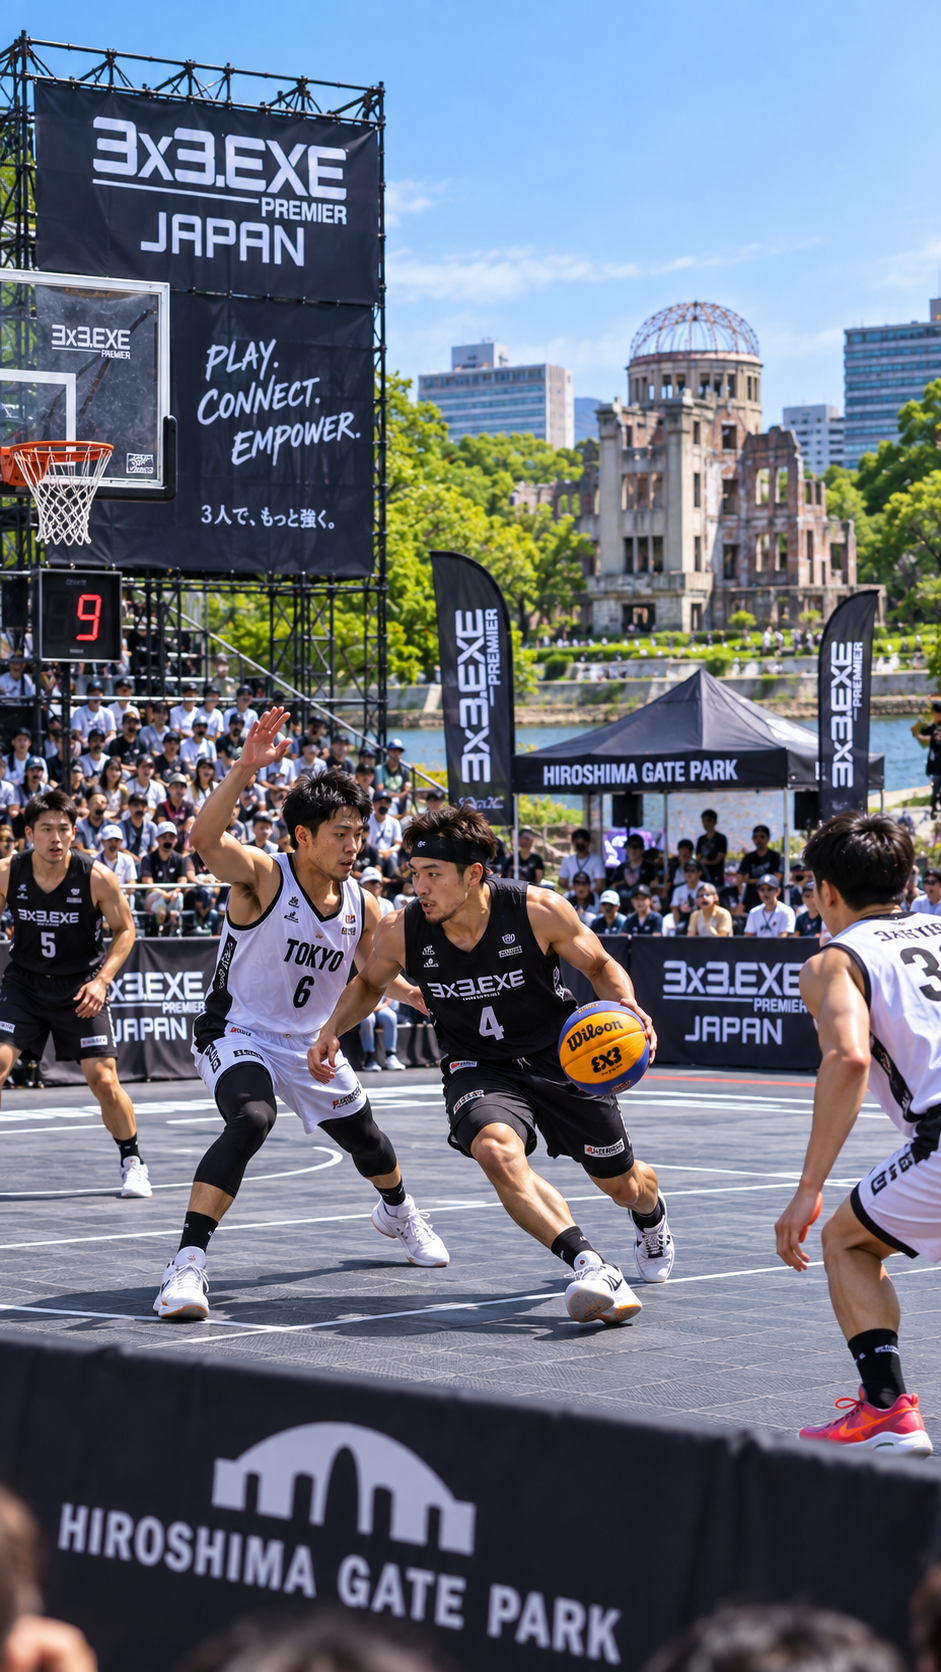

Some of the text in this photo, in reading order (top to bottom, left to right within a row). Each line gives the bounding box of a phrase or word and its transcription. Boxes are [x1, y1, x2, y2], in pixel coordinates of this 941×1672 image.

[93, 116, 347, 200] 3x3.EXE
[261, 197, 347, 225] PREMIER
[140, 211, 305, 266] JAPAN
[205, 338, 279, 382] PLAY.
[197, 374, 321, 426] CONNECT.
[231, 411, 361, 467] EMPOWER.
[200, 504, 336, 530] 3人で、もっと強く。
[76, 594, 102, 641] 9
[485, 608, 501, 686] PREMIER
[852, 641, 864, 708] PREMIER
[543, 759, 738, 786] HIROSHIMA GATE PARK
[41, 931, 56, 958] 5
[284, 938, 344, 972] TOKYO
[162, 1001, 205, 1014] PREMIER
[293, 975, 315, 1009] 6
[752, 997, 808, 1014] PREMIER
[478, 1005, 505, 1041] 4
[567, 1020, 624, 1052] Wilson
[684, 1015, 782, 1045] JAPAN
[58, 1503, 622, 1665] HIROSHIMA GATE PARK
